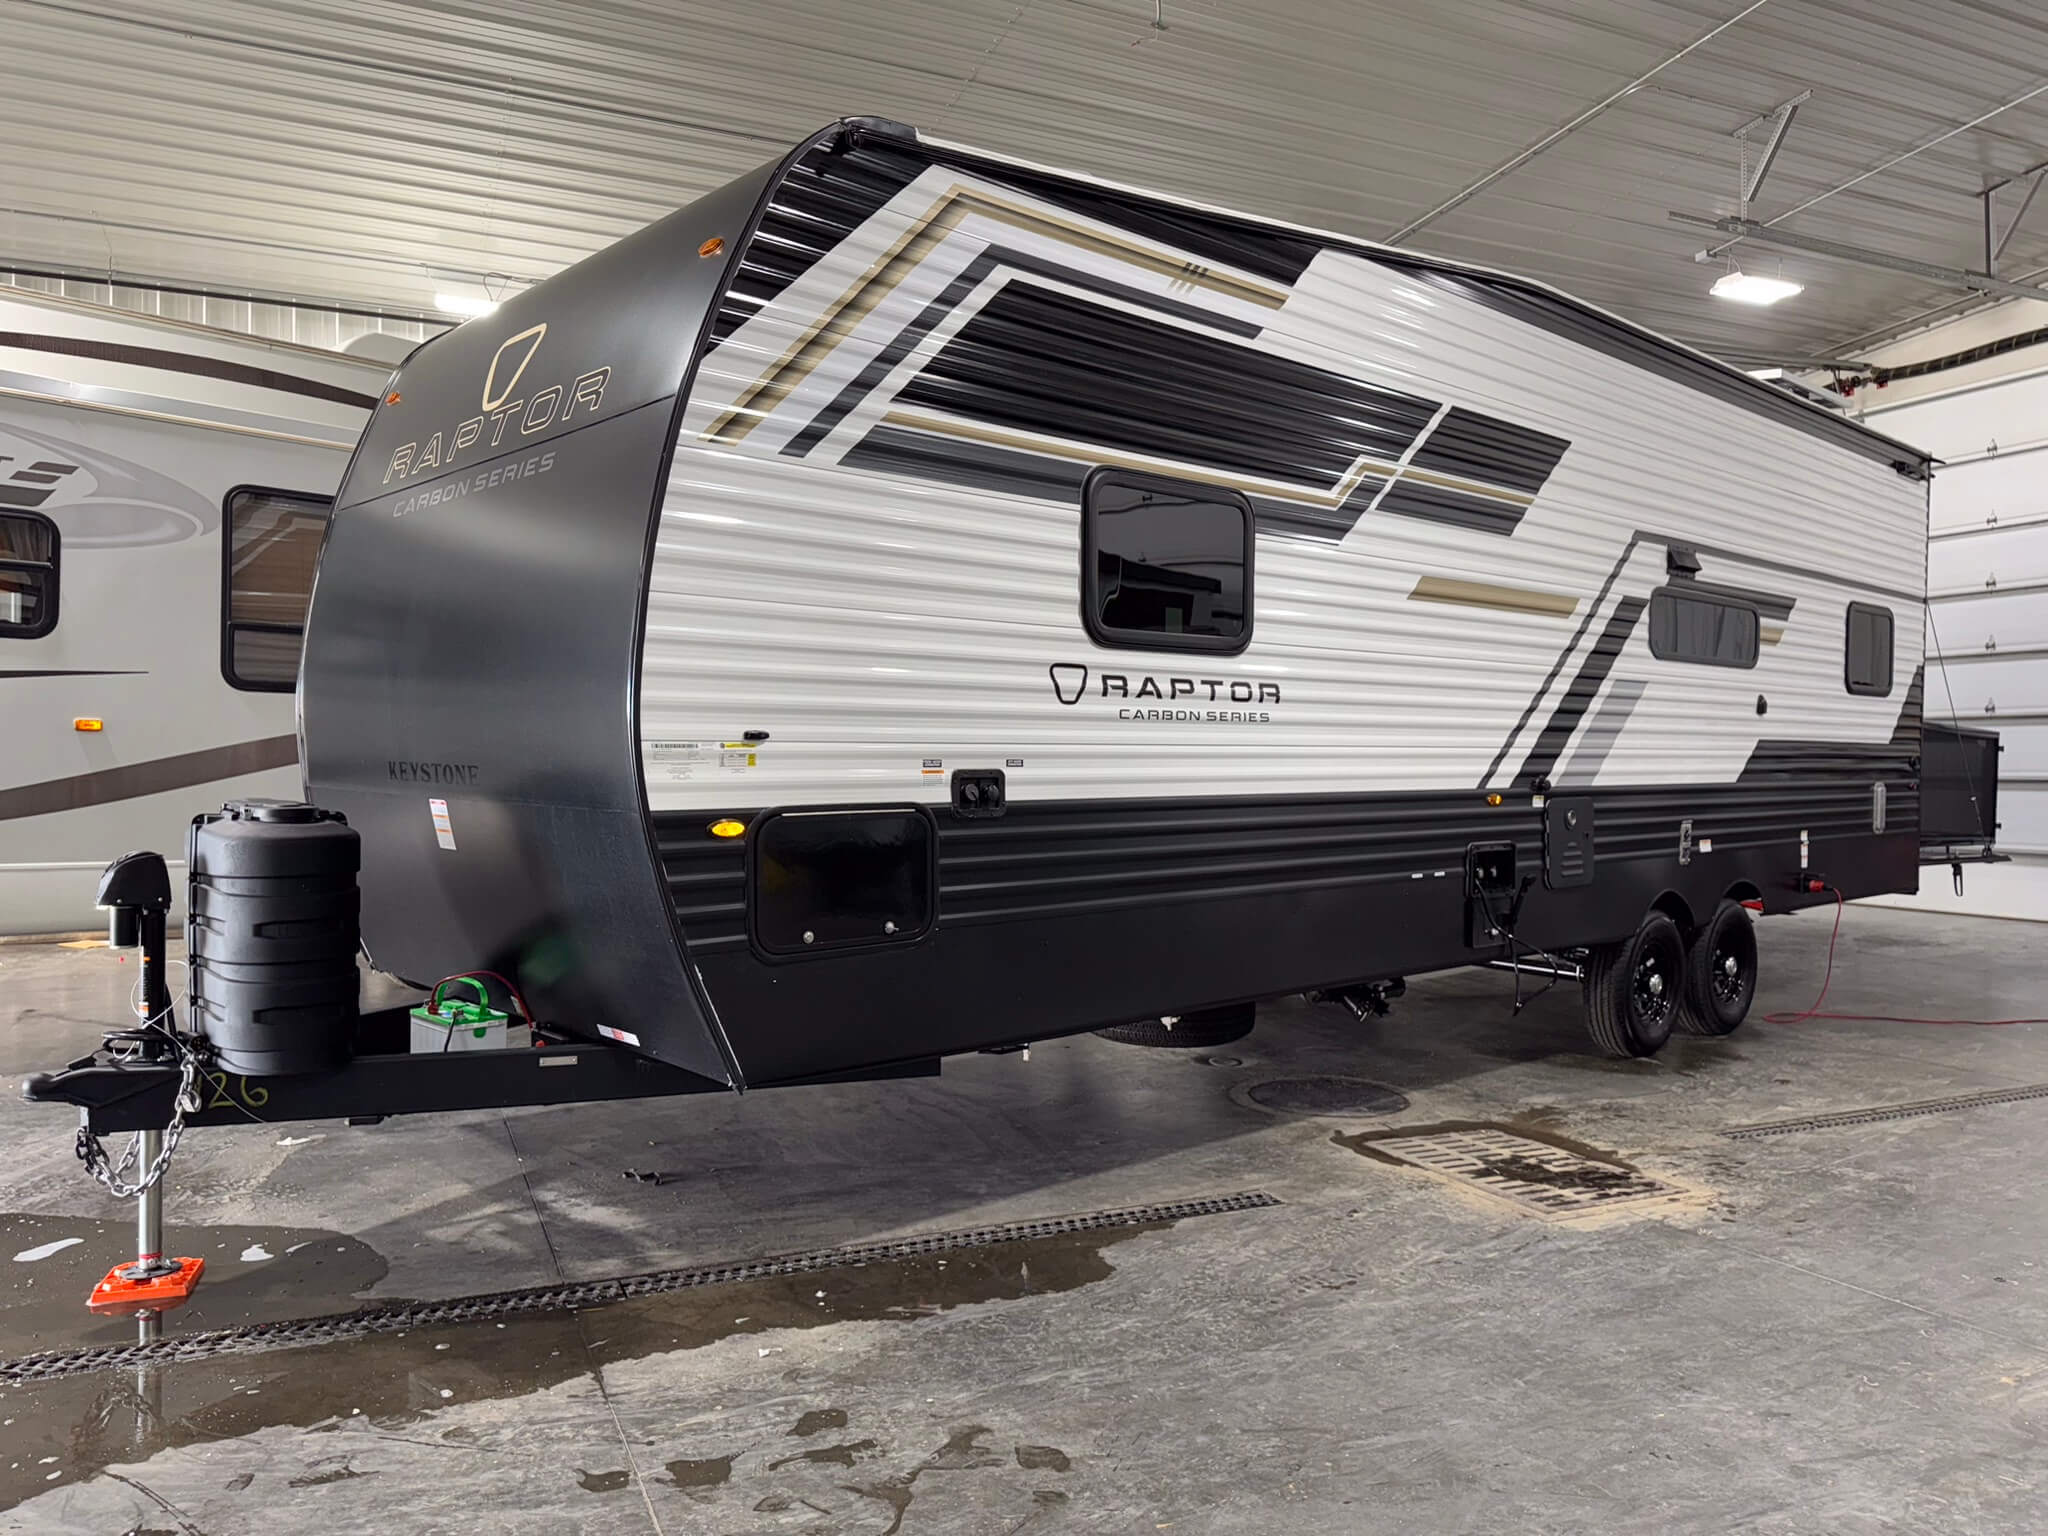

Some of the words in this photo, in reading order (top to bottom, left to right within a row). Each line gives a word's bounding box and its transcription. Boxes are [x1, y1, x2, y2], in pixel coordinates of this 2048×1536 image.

[382, 365, 612, 485] RAPTOR
[392, 480, 471, 518] CARBON
[473, 452, 557, 493] SERIES
[1101, 674, 1281, 704] RAPTOR
[1118, 708, 1201, 721] CARBON
[1206, 711, 1271, 723] SERIES
[387, 760, 480, 785] KEYSTONE
